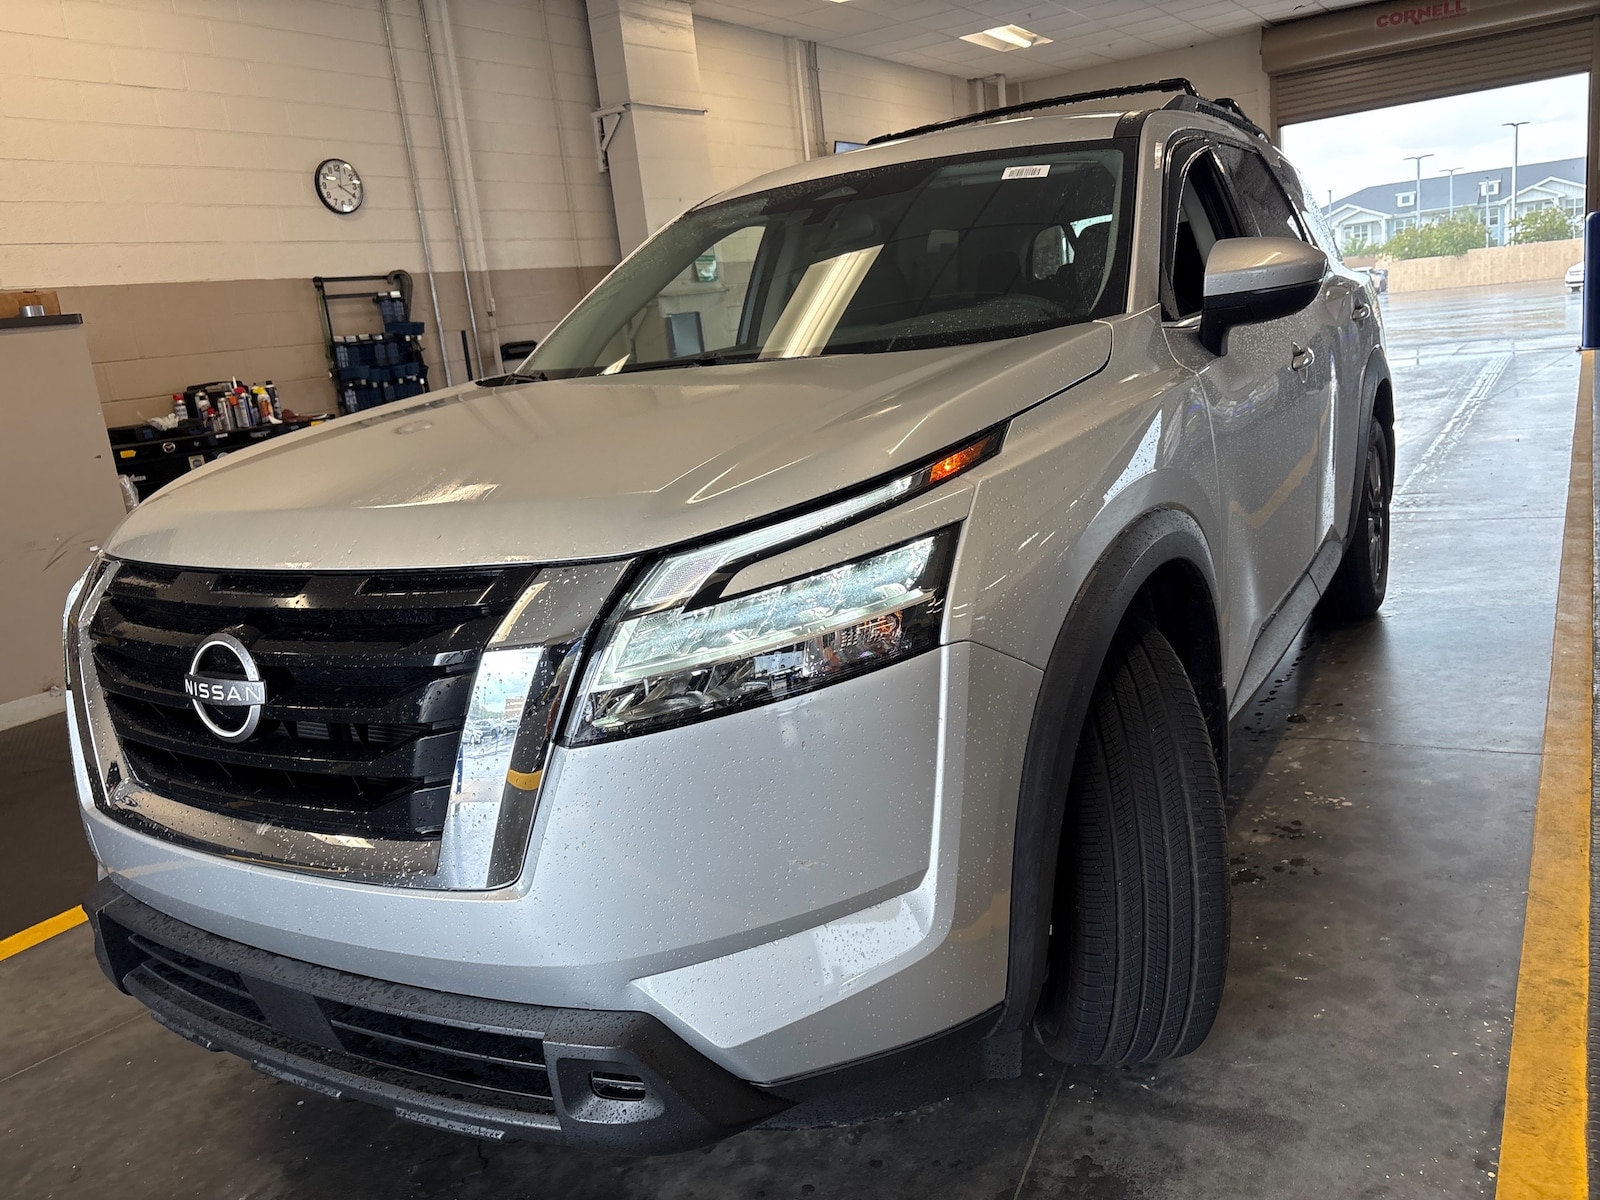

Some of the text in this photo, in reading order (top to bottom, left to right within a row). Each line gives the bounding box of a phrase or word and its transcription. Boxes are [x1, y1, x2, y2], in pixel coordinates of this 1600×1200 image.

[1376, 0, 1467, 28] CORNELL
[333, 164, 340, 173] 12
[322, 182, 327, 190] 9
[185, 679, 260, 701] NISSAN
